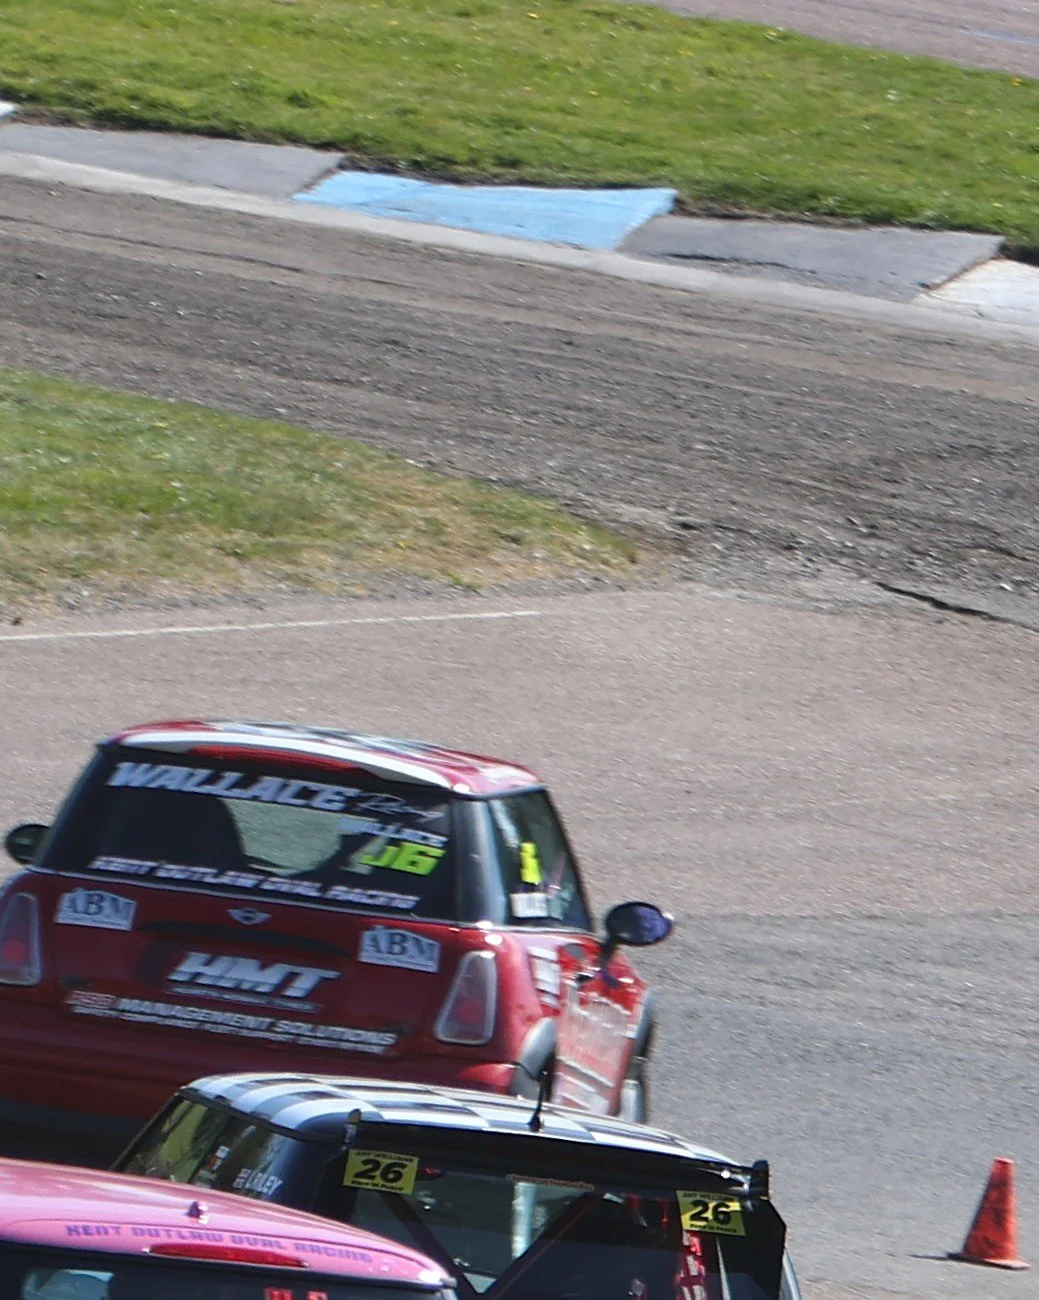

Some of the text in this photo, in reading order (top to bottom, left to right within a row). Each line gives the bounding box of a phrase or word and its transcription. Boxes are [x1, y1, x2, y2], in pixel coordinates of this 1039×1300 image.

[106, 762, 362, 811] WALLACE
[167, 951, 341, 998] HMT
[117, 997, 274, 1030] MANAGEMENT
[353, 1158, 408, 1183] 26
[689, 1199, 731, 1226] 26
[65, 1224, 122, 1237] KENT
